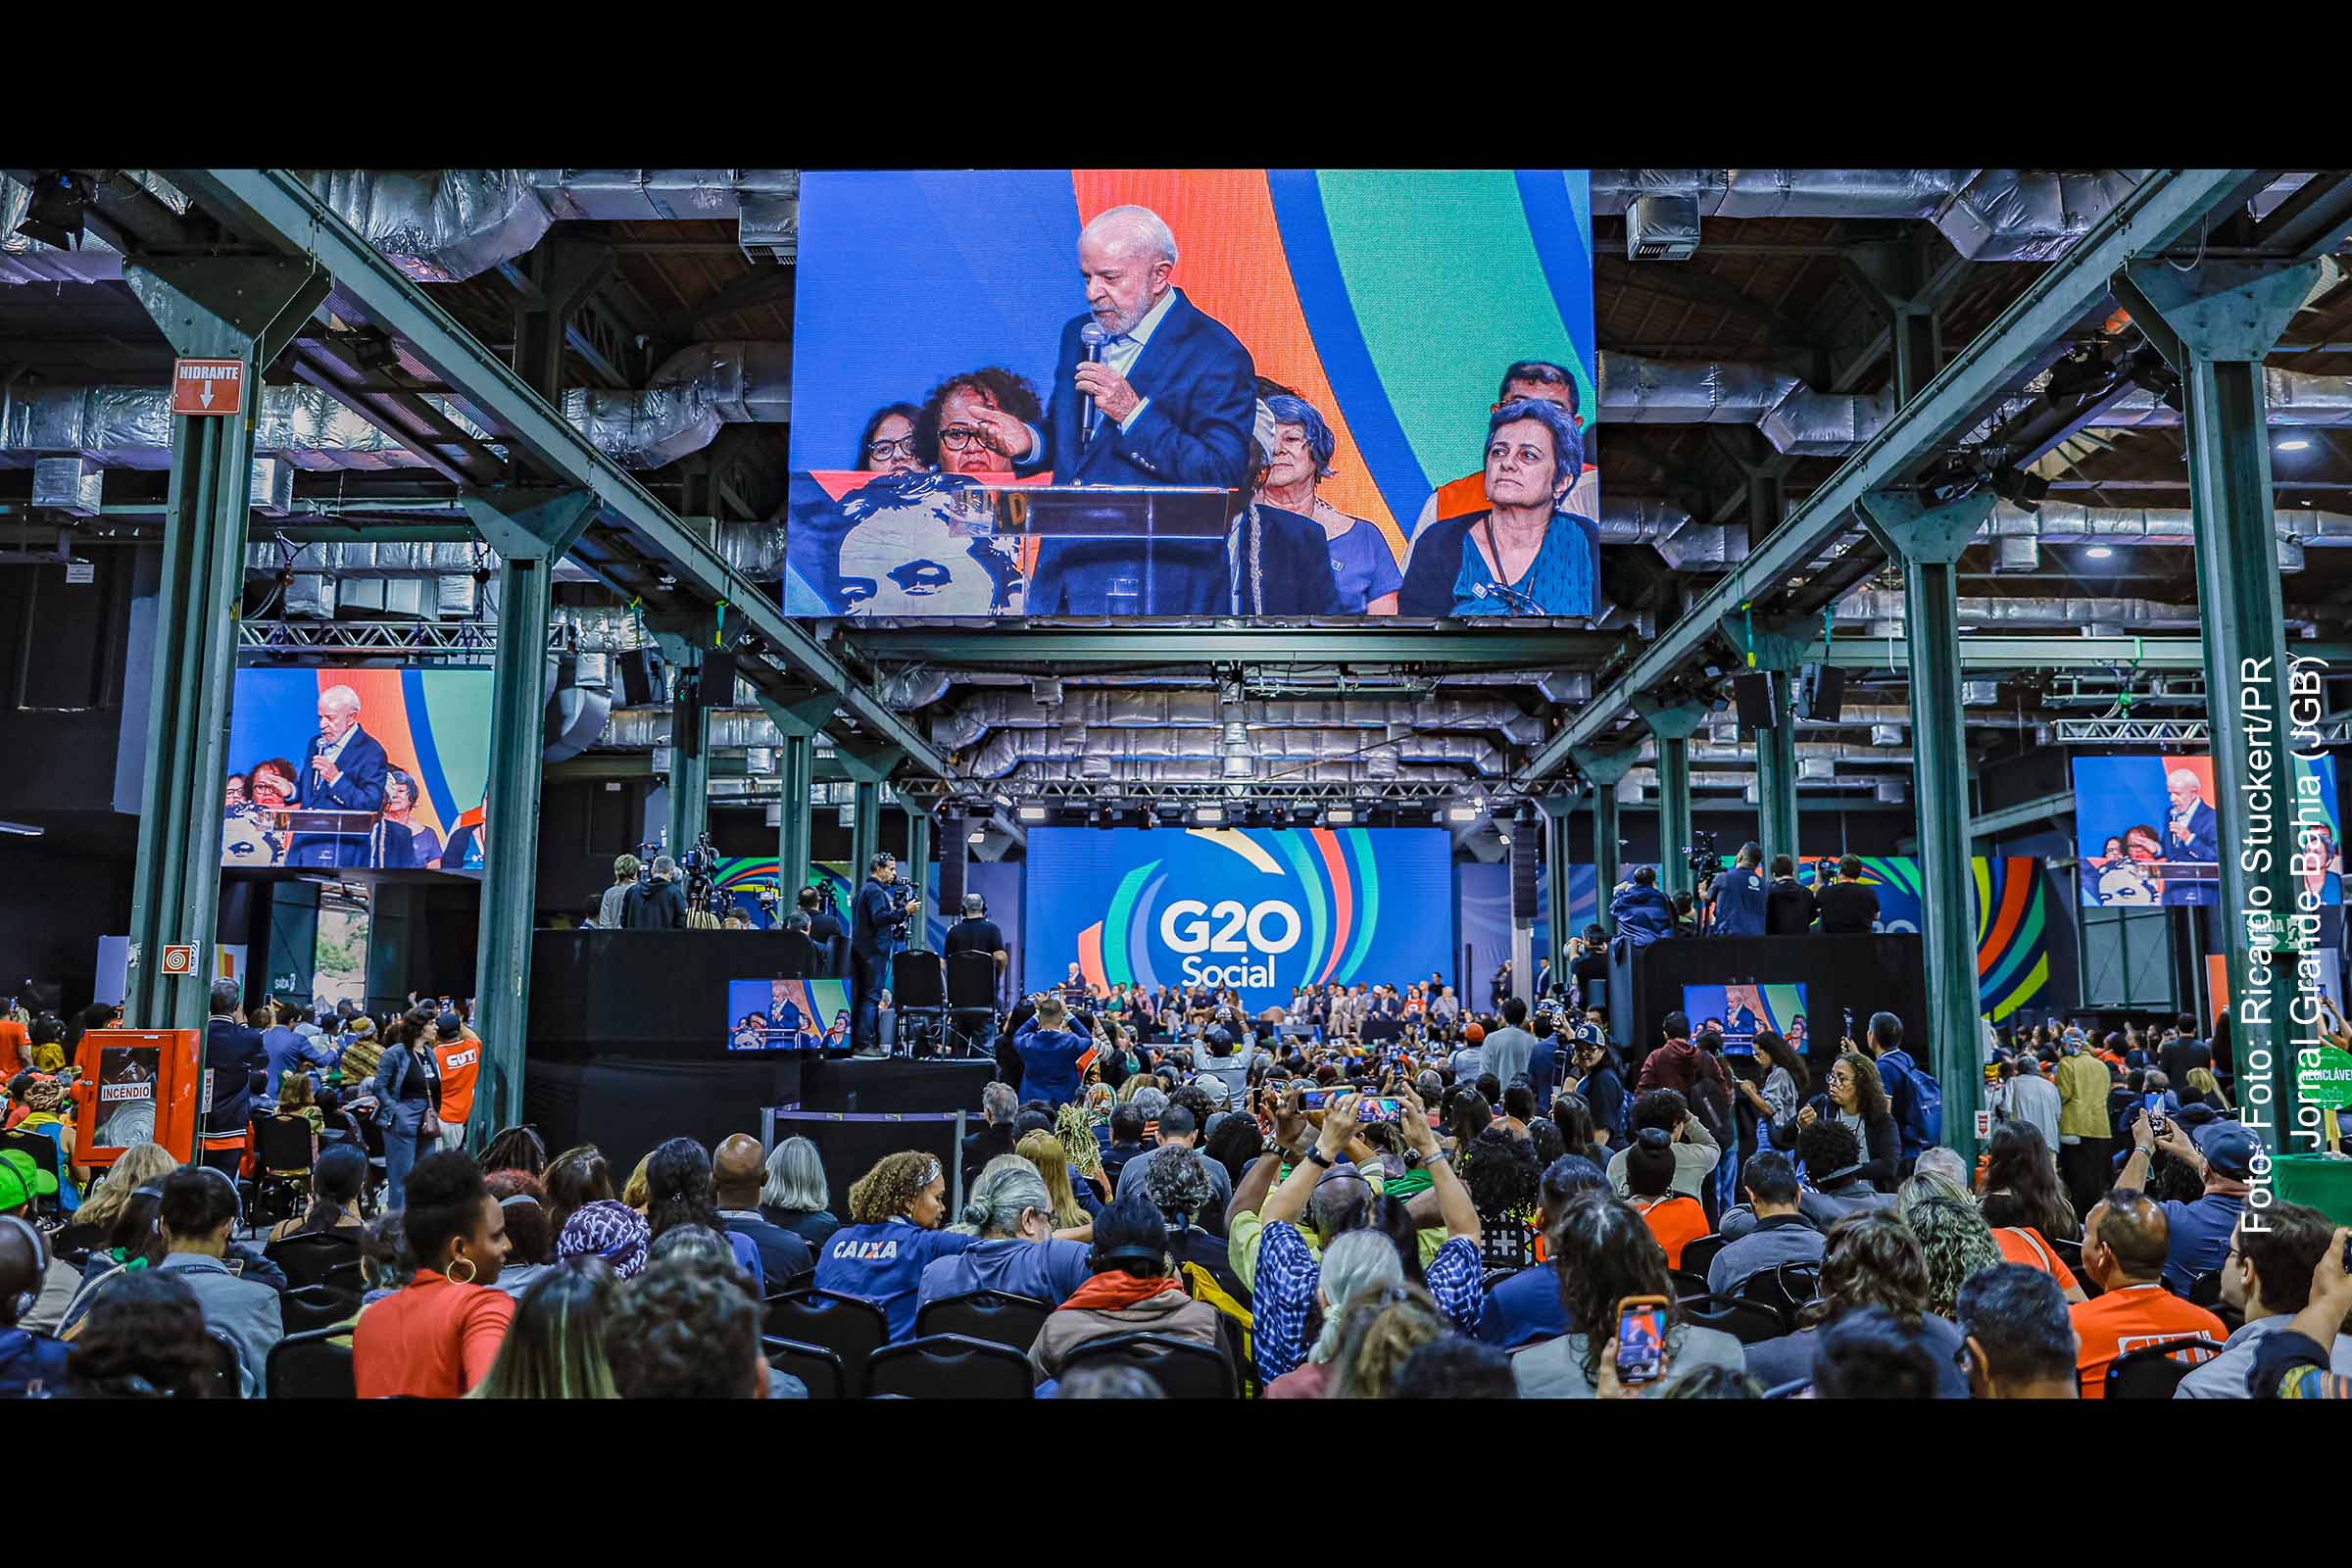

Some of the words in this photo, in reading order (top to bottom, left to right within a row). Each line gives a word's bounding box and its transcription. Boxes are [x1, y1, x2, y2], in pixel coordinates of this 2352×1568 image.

[179, 366, 239, 380] HIDRANTE
[1160, 900, 1301, 954] G20
[1182, 955, 1275, 988] Social
[446, 1050, 476, 1068] CUT
[102, 1084, 150, 1100] INCÊNDIO
[833, 1240, 898, 1259] CAIXA
